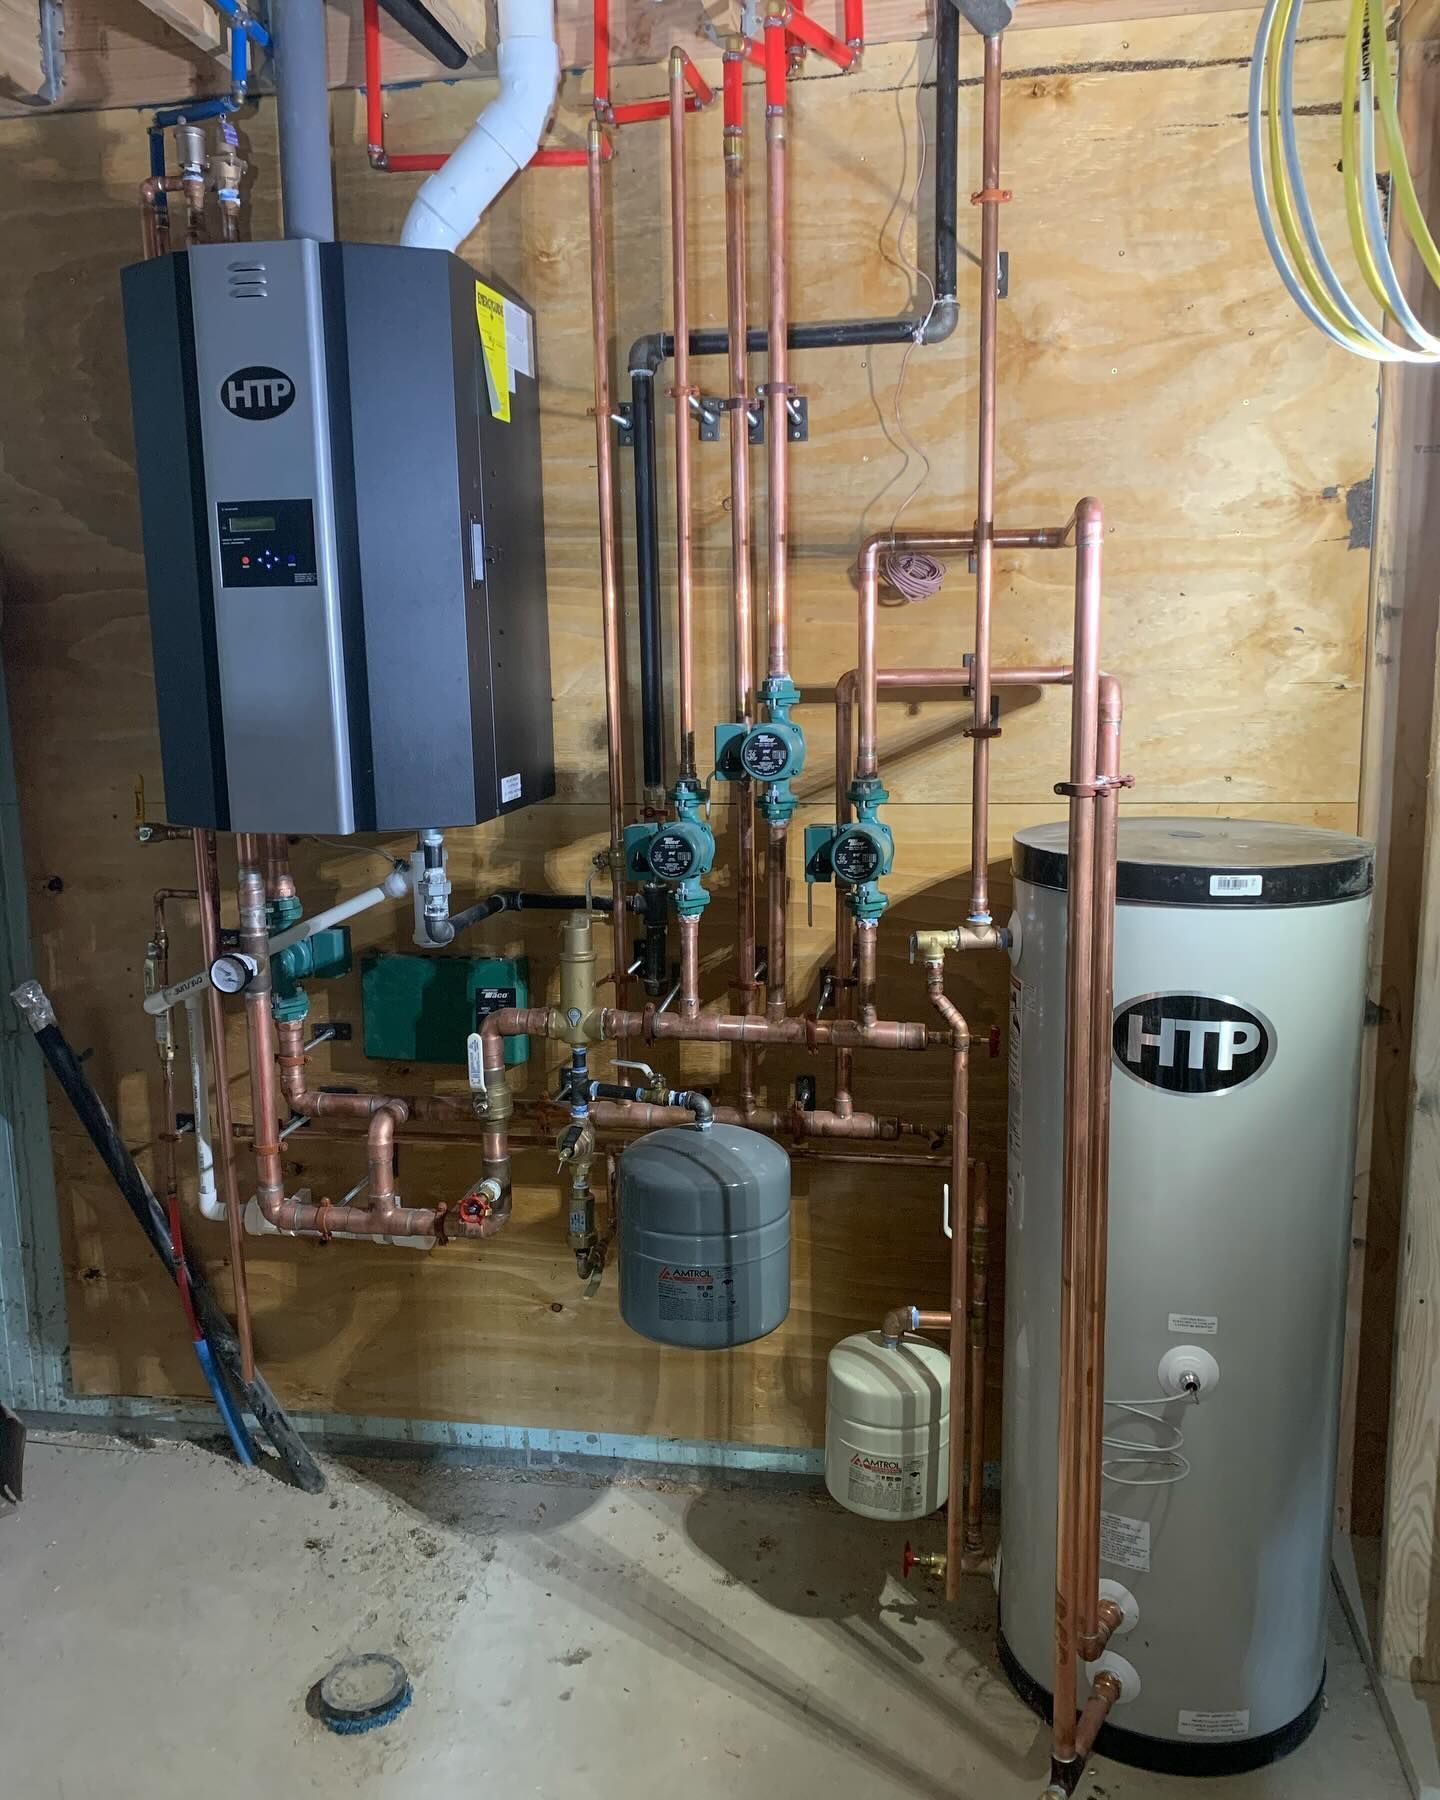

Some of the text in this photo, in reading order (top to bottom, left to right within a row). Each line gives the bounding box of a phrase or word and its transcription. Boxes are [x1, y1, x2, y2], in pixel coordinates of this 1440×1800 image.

[227, 378, 291, 409] HTP
[481, 988, 510, 999] Taco
[1127, 1013, 1261, 1071] HTP
[672, 1268, 710, 1278] AMTROL
[862, 1457, 899, 1470] AMTROL
